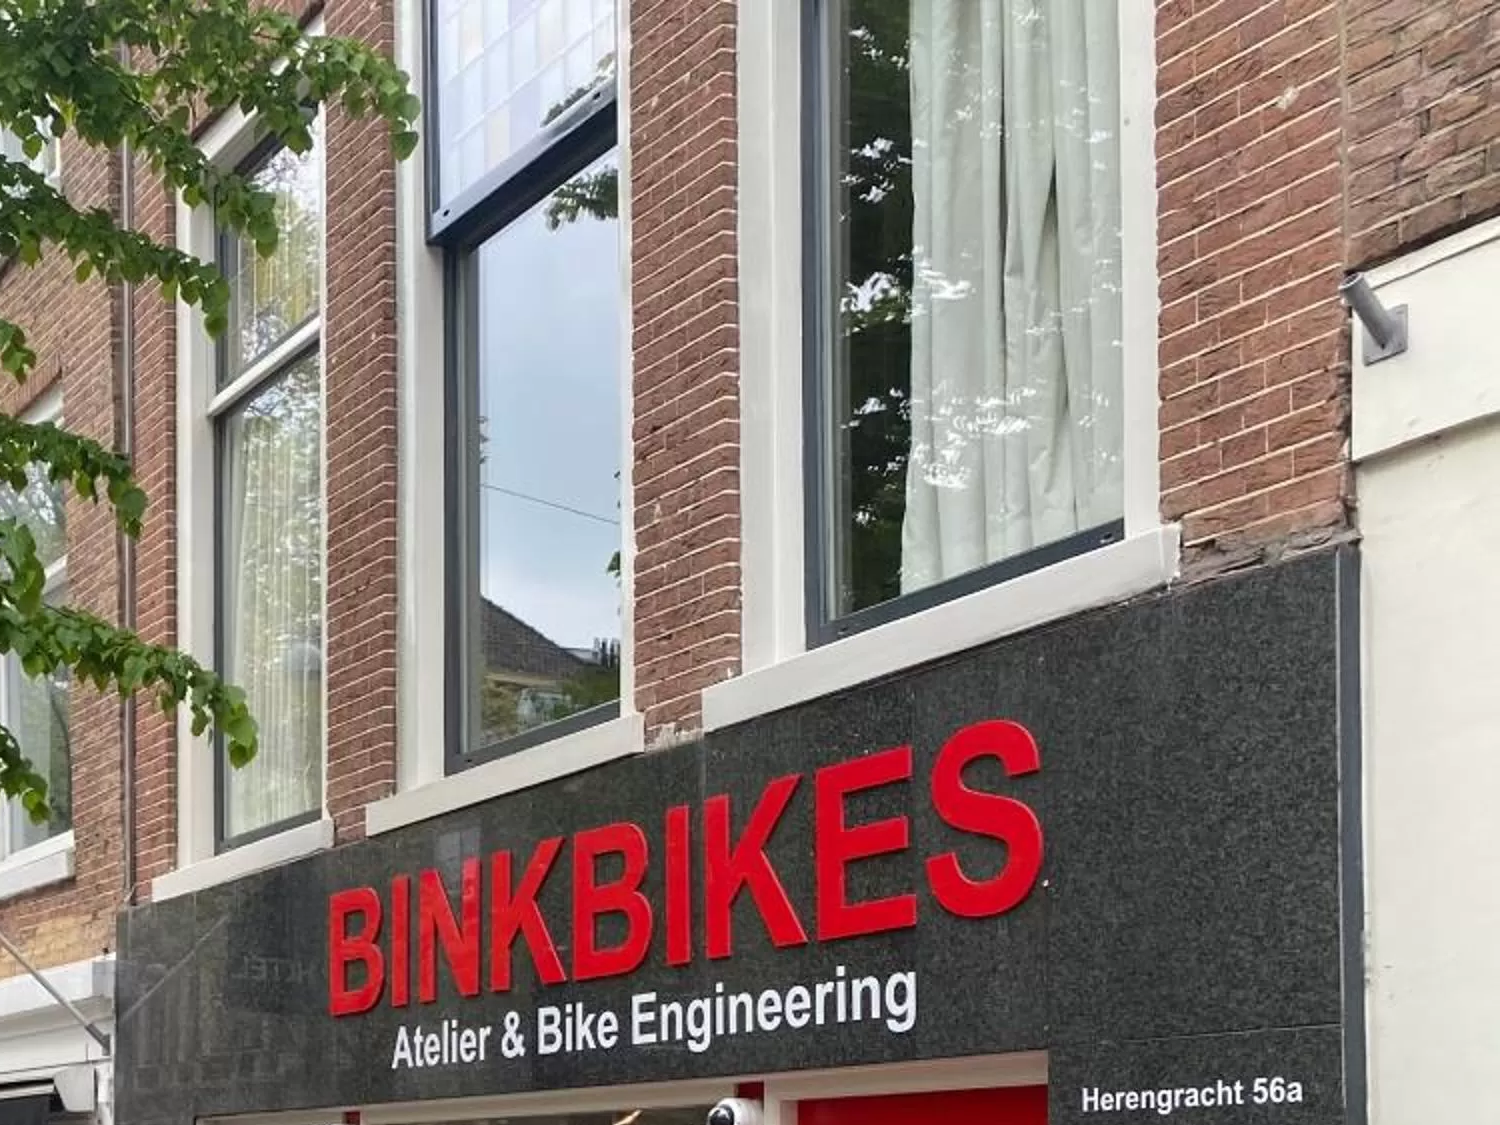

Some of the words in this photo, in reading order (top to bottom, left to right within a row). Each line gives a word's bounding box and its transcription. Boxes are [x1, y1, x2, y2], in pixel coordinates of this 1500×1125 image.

[328, 719, 1045, 1018] BINKBIKES
[392, 1020, 490, 1070] Atelier
[501, 1012, 525, 1058] &
[537, 1000, 619, 1055] Bike
[631, 965, 918, 1054] Engineering
[1081, 1080, 1245, 1115] Herengracht
[1253, 1078, 1303, 1103] 56a
